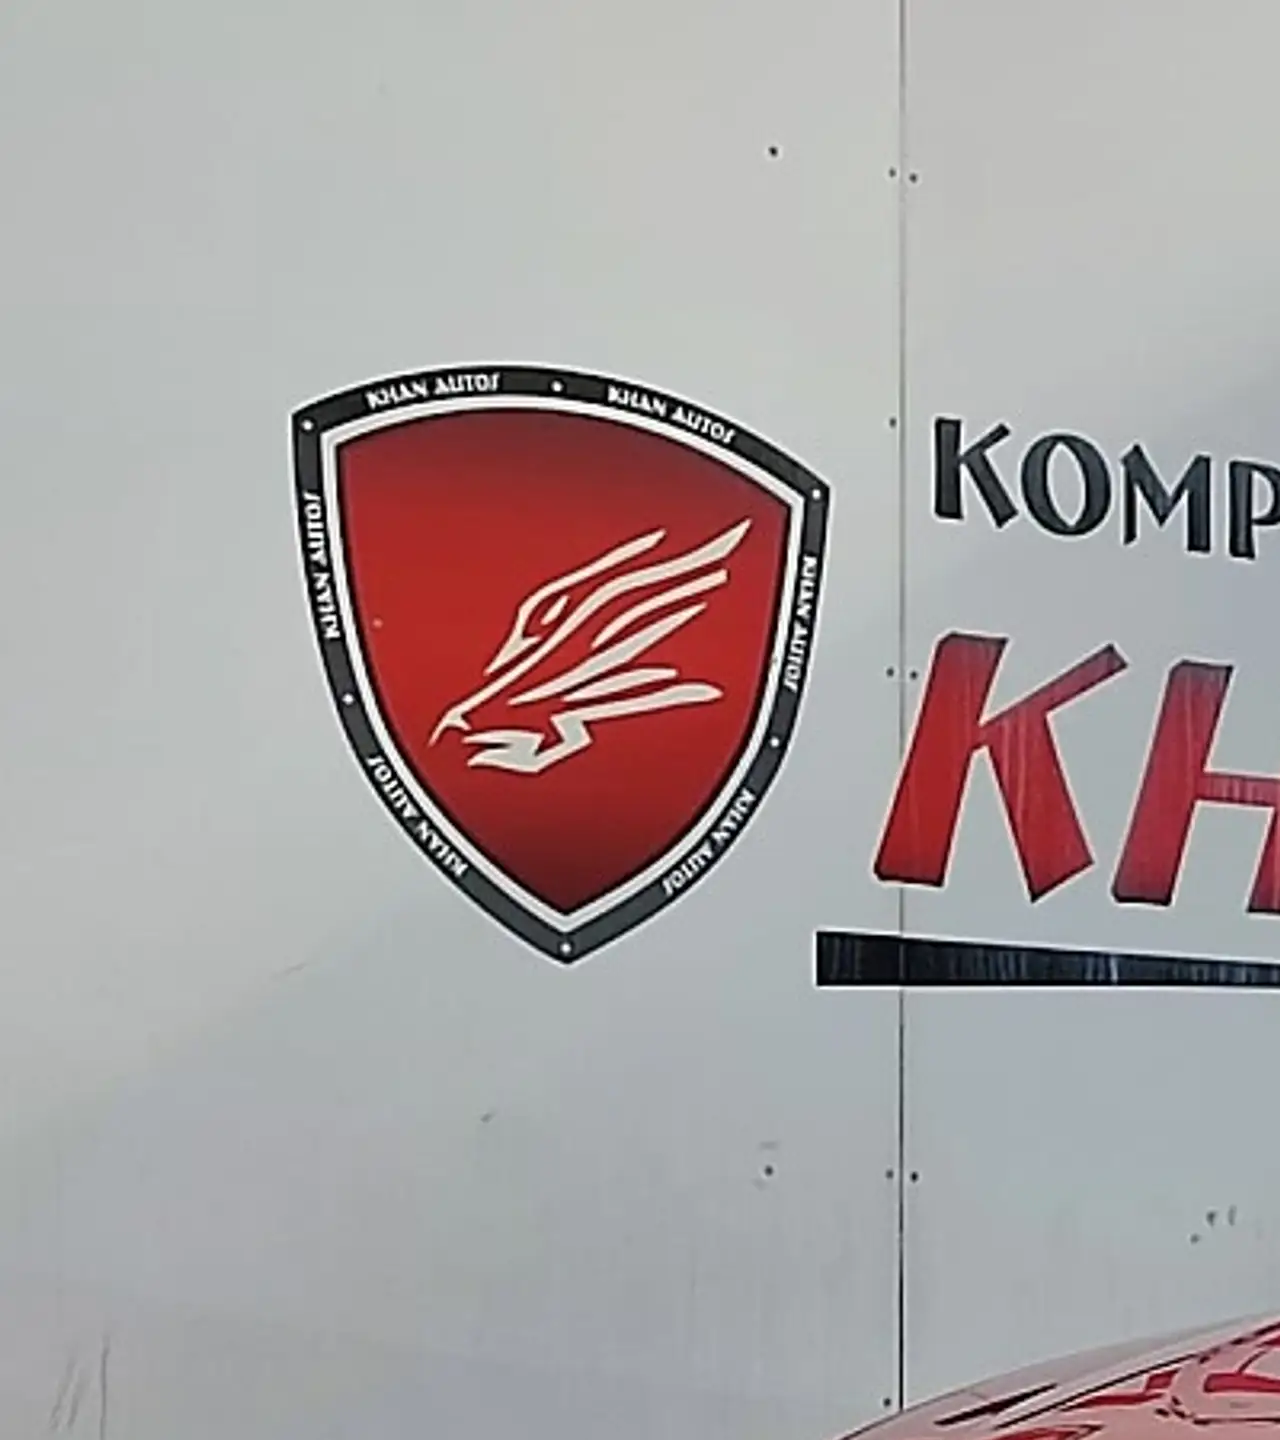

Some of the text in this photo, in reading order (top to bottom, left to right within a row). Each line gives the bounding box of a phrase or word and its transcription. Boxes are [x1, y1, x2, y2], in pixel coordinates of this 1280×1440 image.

[366, 373, 500, 410] KHAN AUTOS
[607, 385, 736, 444] KHAN AUTOS
